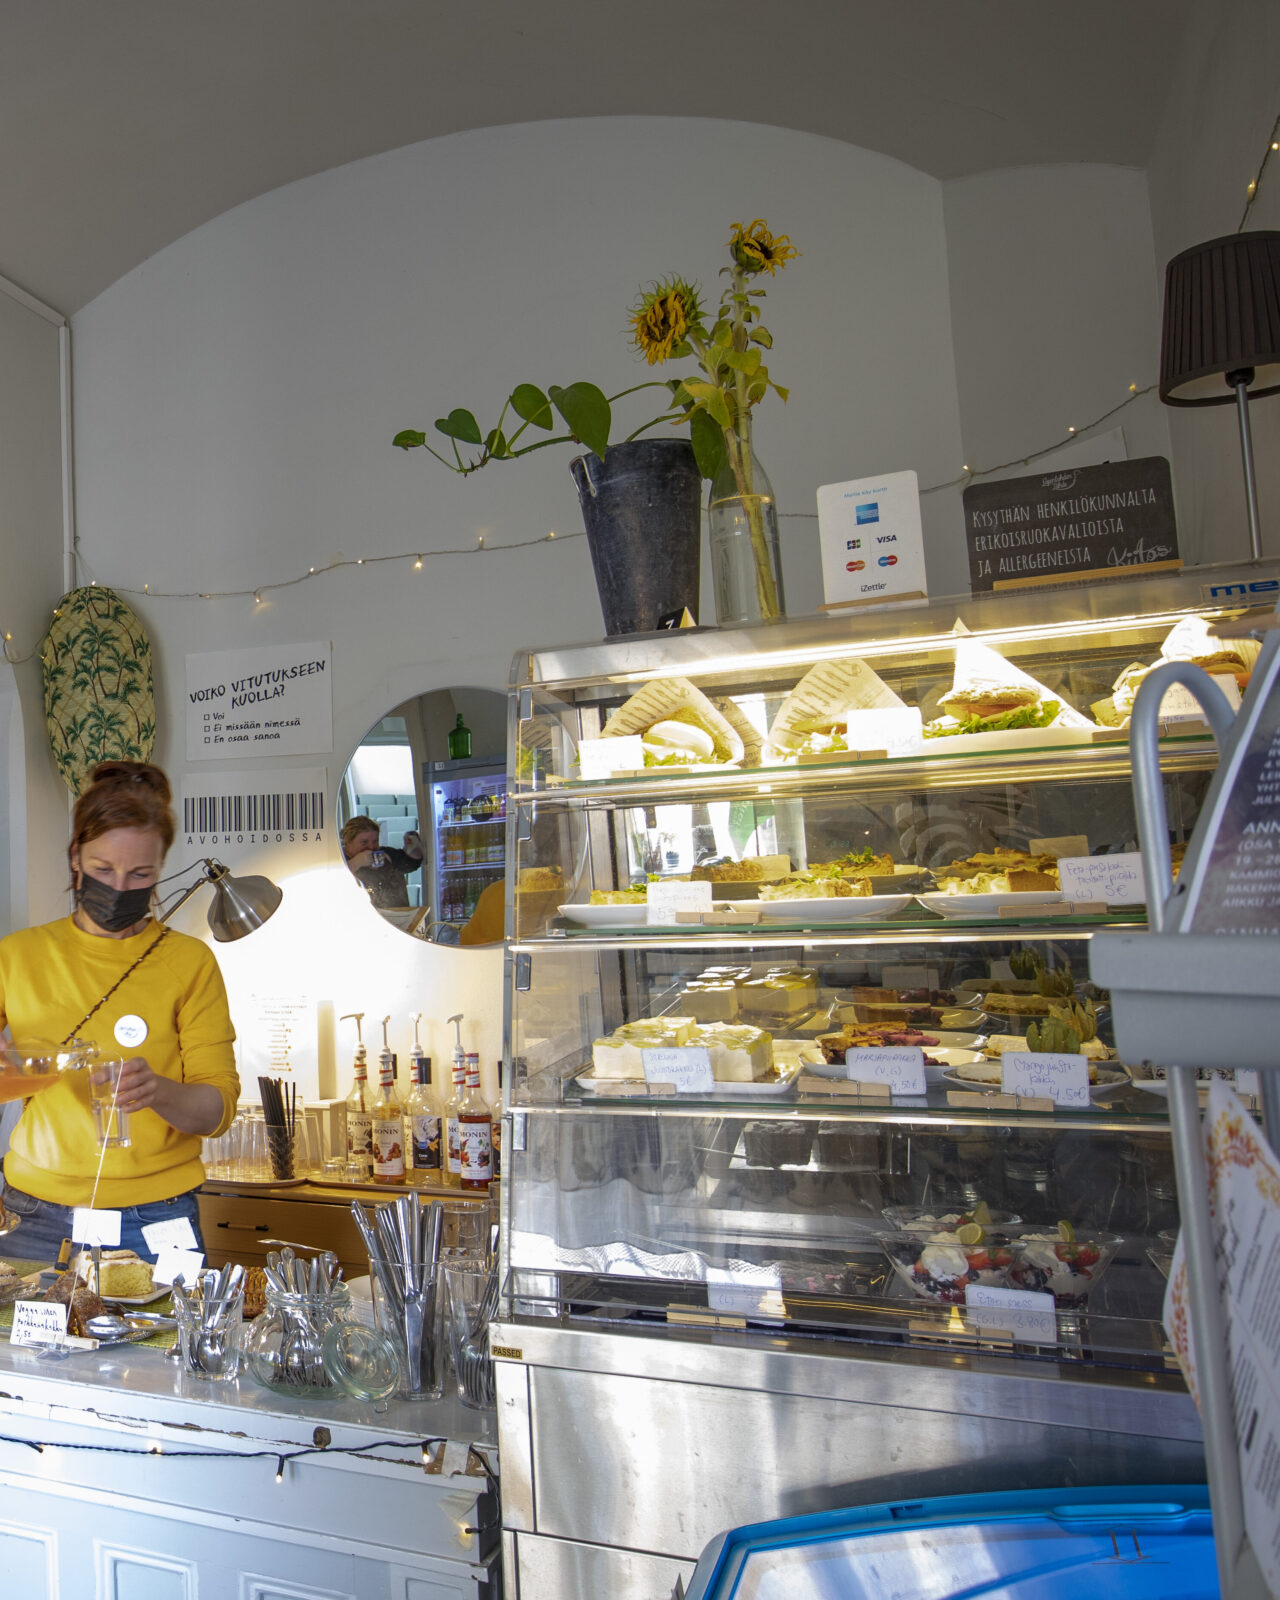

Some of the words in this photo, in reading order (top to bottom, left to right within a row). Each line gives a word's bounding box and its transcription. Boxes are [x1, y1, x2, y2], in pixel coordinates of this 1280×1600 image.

[1037, 488, 1156, 520] HENKILÖKUNNALTA
[876, 534, 897, 544] VISA
[975, 518, 1124, 552] ERIKOISRUOKAVALIOISTA
[978, 558, 992, 578] JA
[999, 546, 1091, 574] ALLERGEENEISTA
[860, 582, 886, 592] iZettle
[190, 684, 226, 704] VOIKO
[231, 660, 326, 693] VITUTUKSEEN
[231, 684, 285, 710] KUOLLA?
[212, 712, 225, 720] Voi
[214, 724, 222, 732] Ei
[226, 720, 260, 731] missään
[264, 718, 301, 728] nimessä
[214, 734, 224, 744] En
[228, 734, 250, 742] osaa
[253, 732, 281, 741] sanoa
[186, 832, 322, 845] AVOHOIDOSSA
